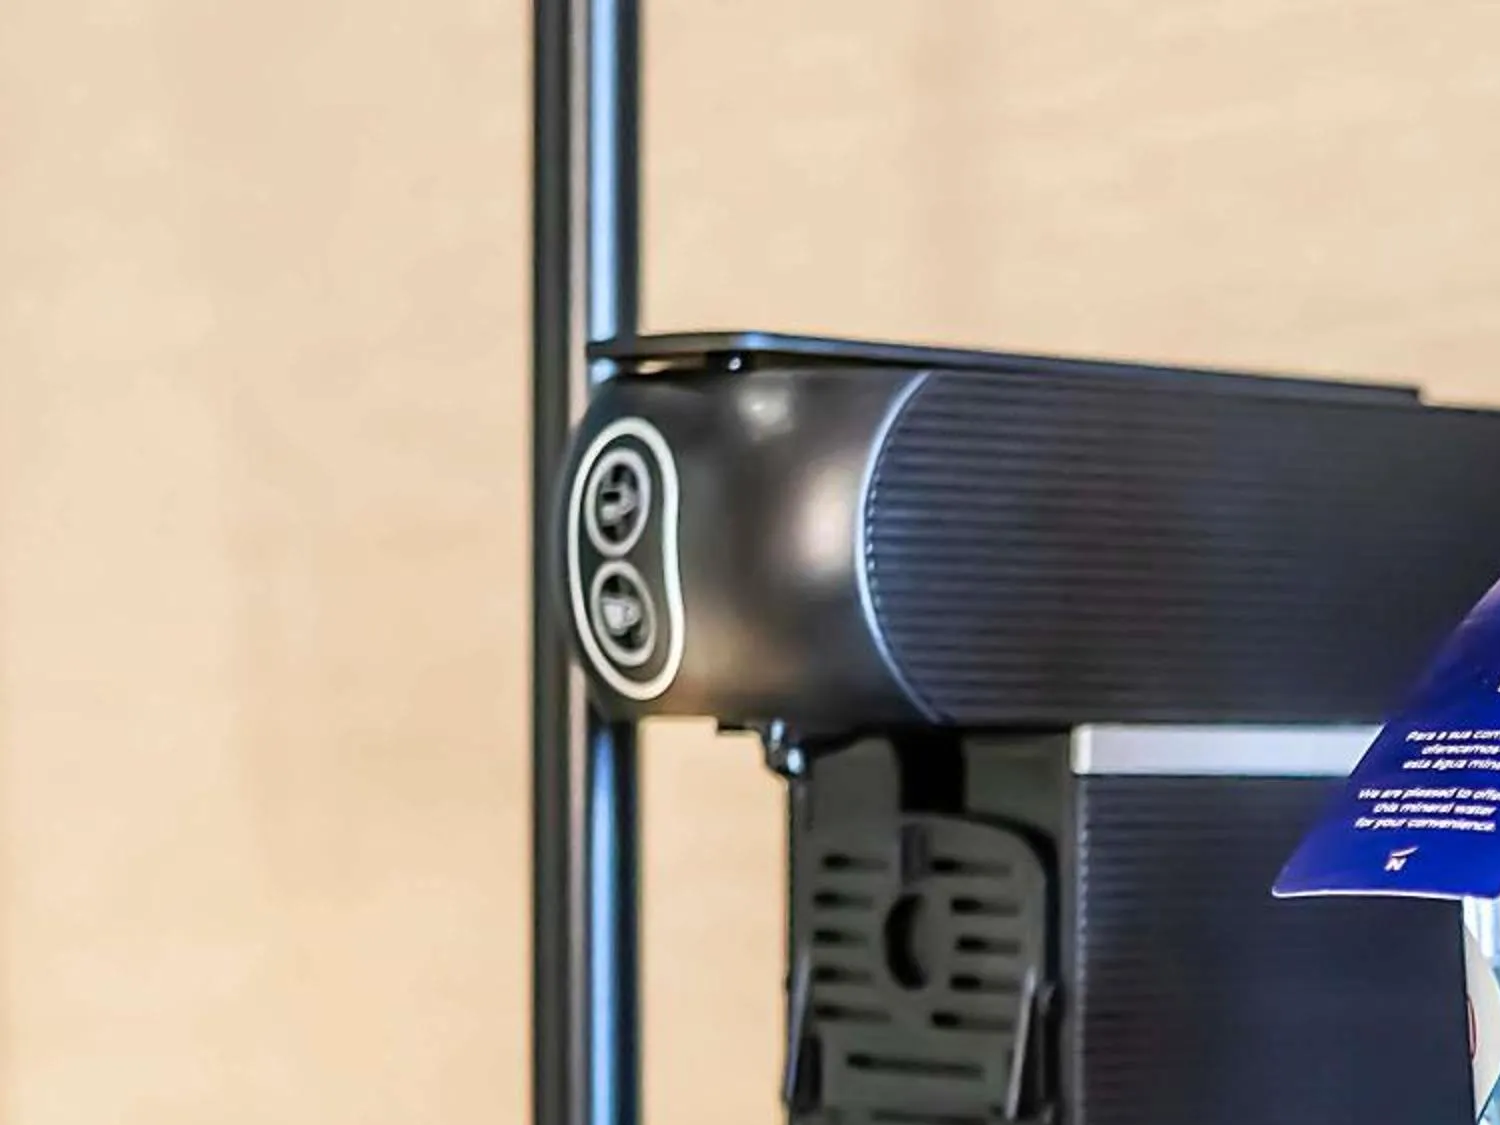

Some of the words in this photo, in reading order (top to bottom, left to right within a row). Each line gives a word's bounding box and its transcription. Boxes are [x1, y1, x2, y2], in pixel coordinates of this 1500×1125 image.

[1357, 788, 1380, 800] We
[1379, 789, 1404, 799] are
[1401, 787, 1457, 801] pleased
[1455, 787, 1472, 799] to
[1372, 802, 1400, 814] this
[1399, 802, 1455, 814] mineral
[1453, 804, 1498, 816] water
[1354, 817, 1376, 829] for
[1373, 818, 1408, 831] your
